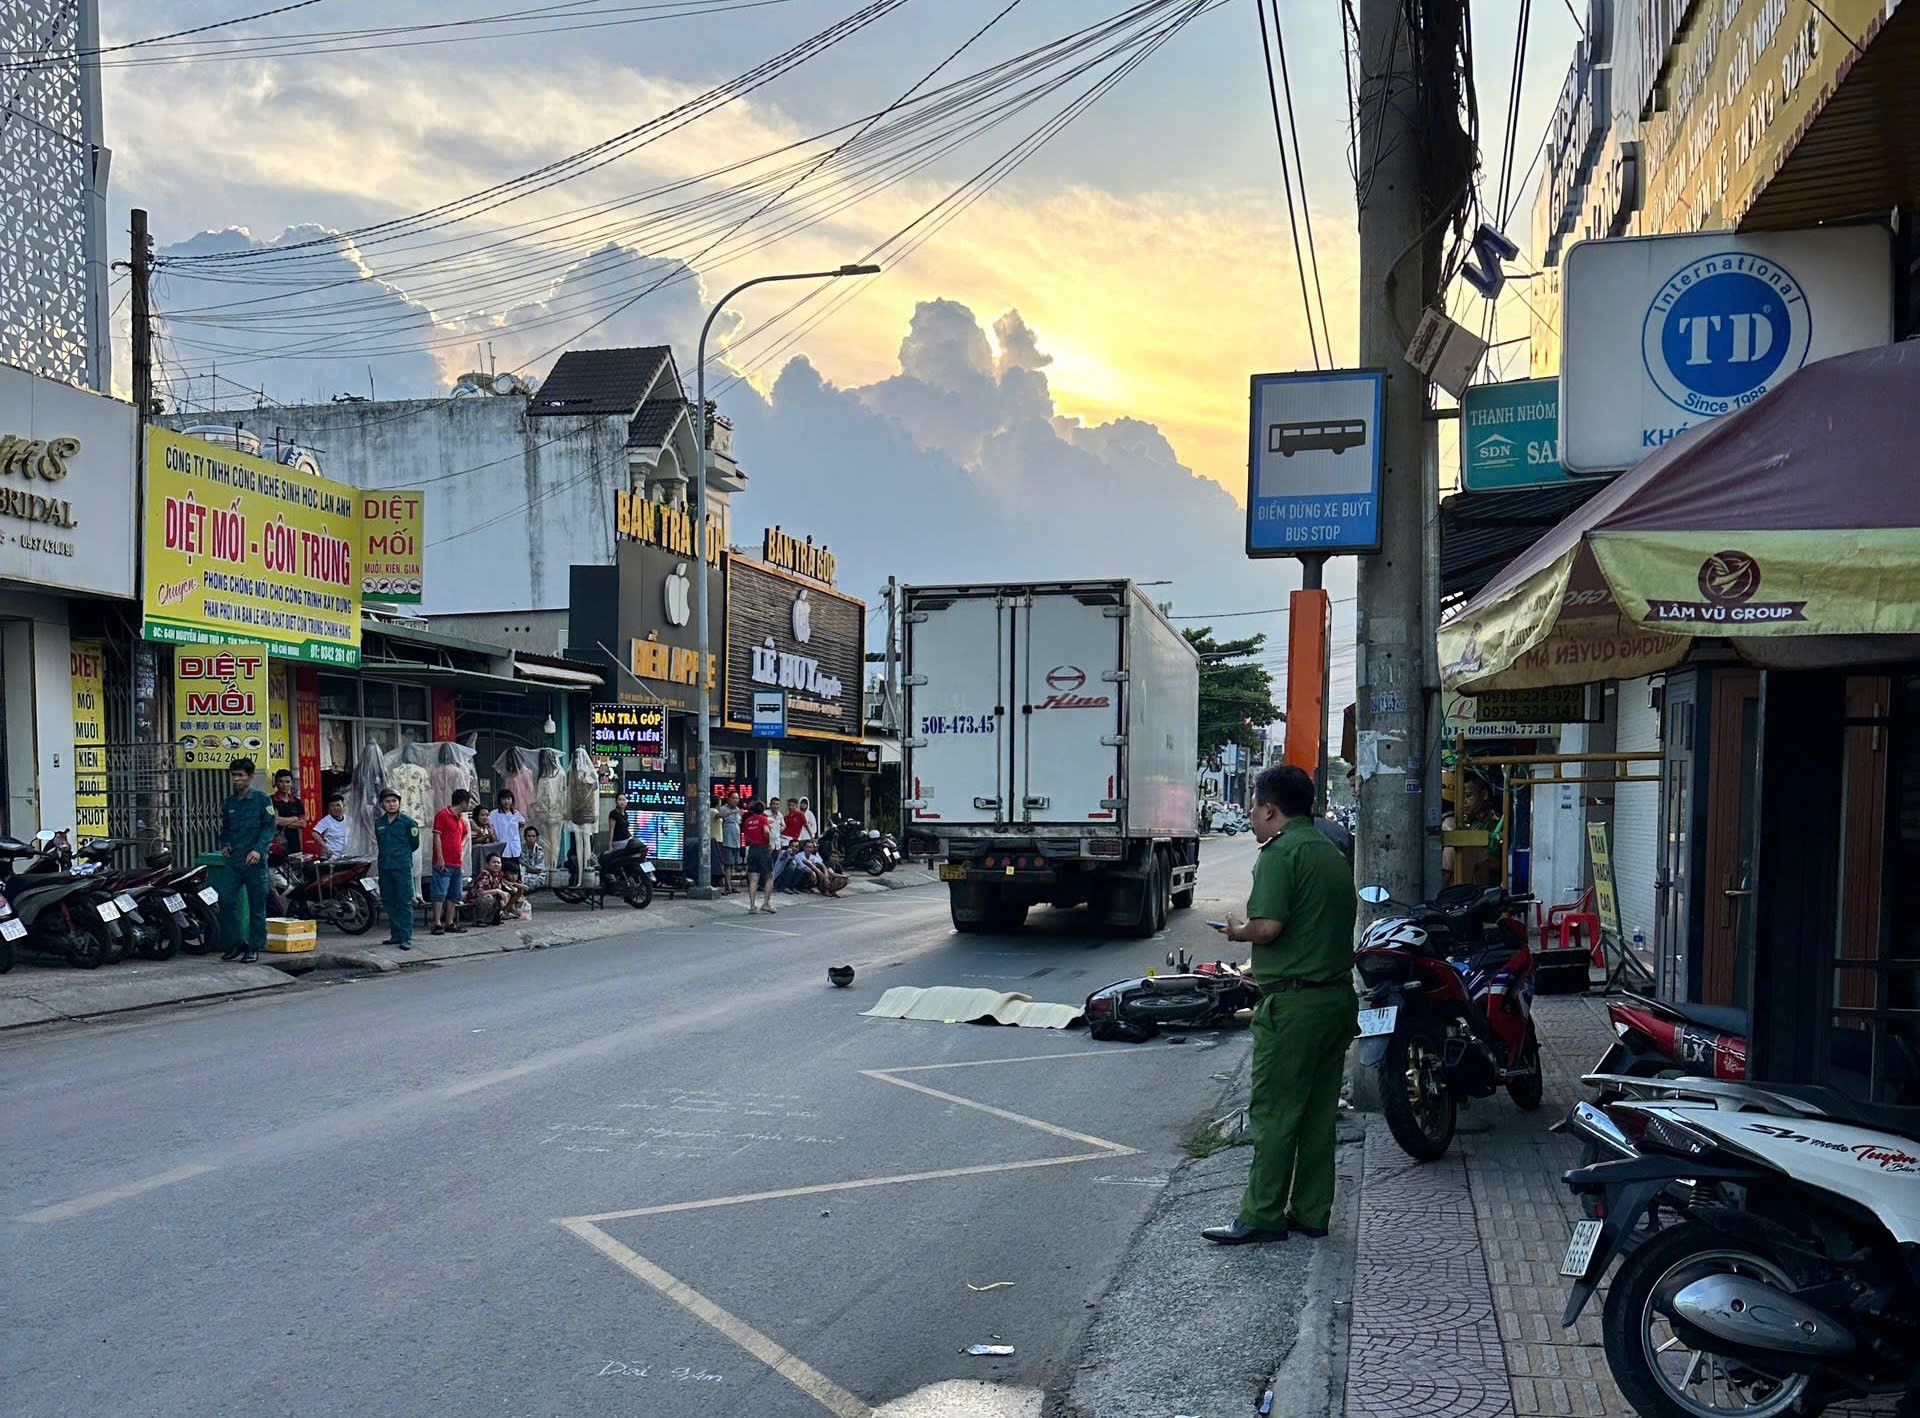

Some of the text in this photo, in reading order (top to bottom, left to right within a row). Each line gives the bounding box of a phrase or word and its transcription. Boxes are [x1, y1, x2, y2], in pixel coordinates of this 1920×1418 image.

[1654, 257, 1801, 313] International
[1678, 313, 1773, 365] TD
[1470, 400, 1556, 426] THANH NHÔM
[1684, 392, 1728, 412] Since
[1480, 446, 1511, 458] SDN
[166, 444, 351, 517] CÔNG TY TNHH CÔNG NGHỆ SINH HỌC LAN ANH
[364, 495, 419, 524] DIỆT
[615, 486, 656, 542] BÁN
[658, 500, 691, 556] TRẢ
[1258, 500, 1371, 521] ĐIỂM DỪNG XE BUÝT
[166, 490, 207, 565] DIỆT
[212, 497, 245, 563] MỐI
[264, 513, 296, 574] CÔN
[301, 525, 350, 585] TRÙNG
[368, 528, 414, 555] MỐI
[1286, 525, 1340, 541] BUS STOP
[765, 525, 793, 569] BÁN
[270, 583, 283, 601] CHO
[1659, 603, 1793, 620] LÂM VŨ GROUP
[71, 652, 99, 683] DIỆT
[179, 651, 262, 683] DIỆT
[670, 646, 716, 688] APPE
[778, 652, 819, 691] HUY
[77, 687, 95, 711] MỐI
[187, 683, 256, 715] MỐI
[1034, 693, 1110, 709] Hino
[595, 709, 661, 725] BÁN TRẢ GÓP
[922, 715, 995, 734] 50E-473.45
[1468, 725, 1552, 736] 0908.90.77.81
[197, 752, 221, 763] 0342
